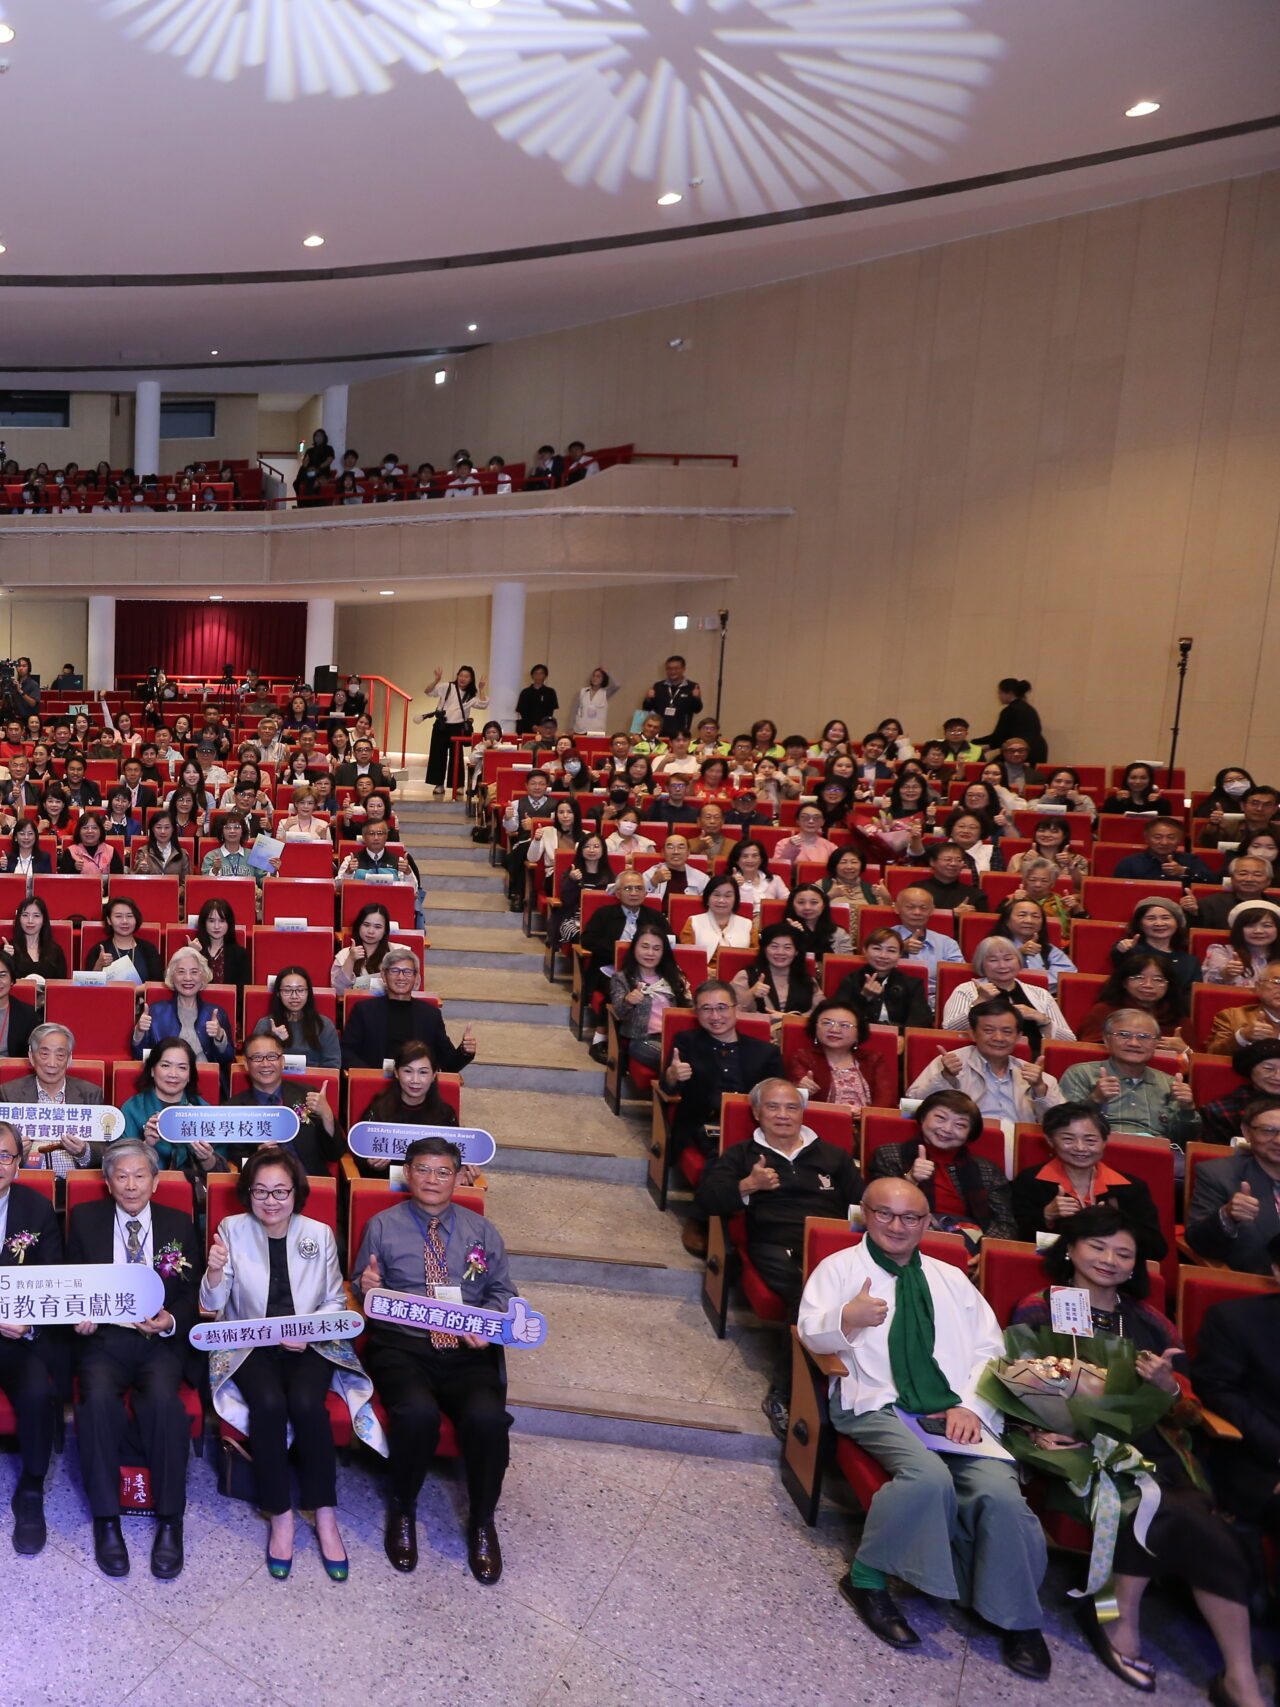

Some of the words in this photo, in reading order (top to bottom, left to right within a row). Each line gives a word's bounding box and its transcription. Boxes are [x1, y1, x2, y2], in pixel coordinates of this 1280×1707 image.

[180, 1120, 272, 1137] 績優學校獎
[16, 1279, 83, 1289] 教育部第十二屆
[371, 1294, 503, 1337] 藝術教育的推手
[205, 1325, 272, 1345] 藝術教育
[280, 1318, 349, 1338] 開展未來
